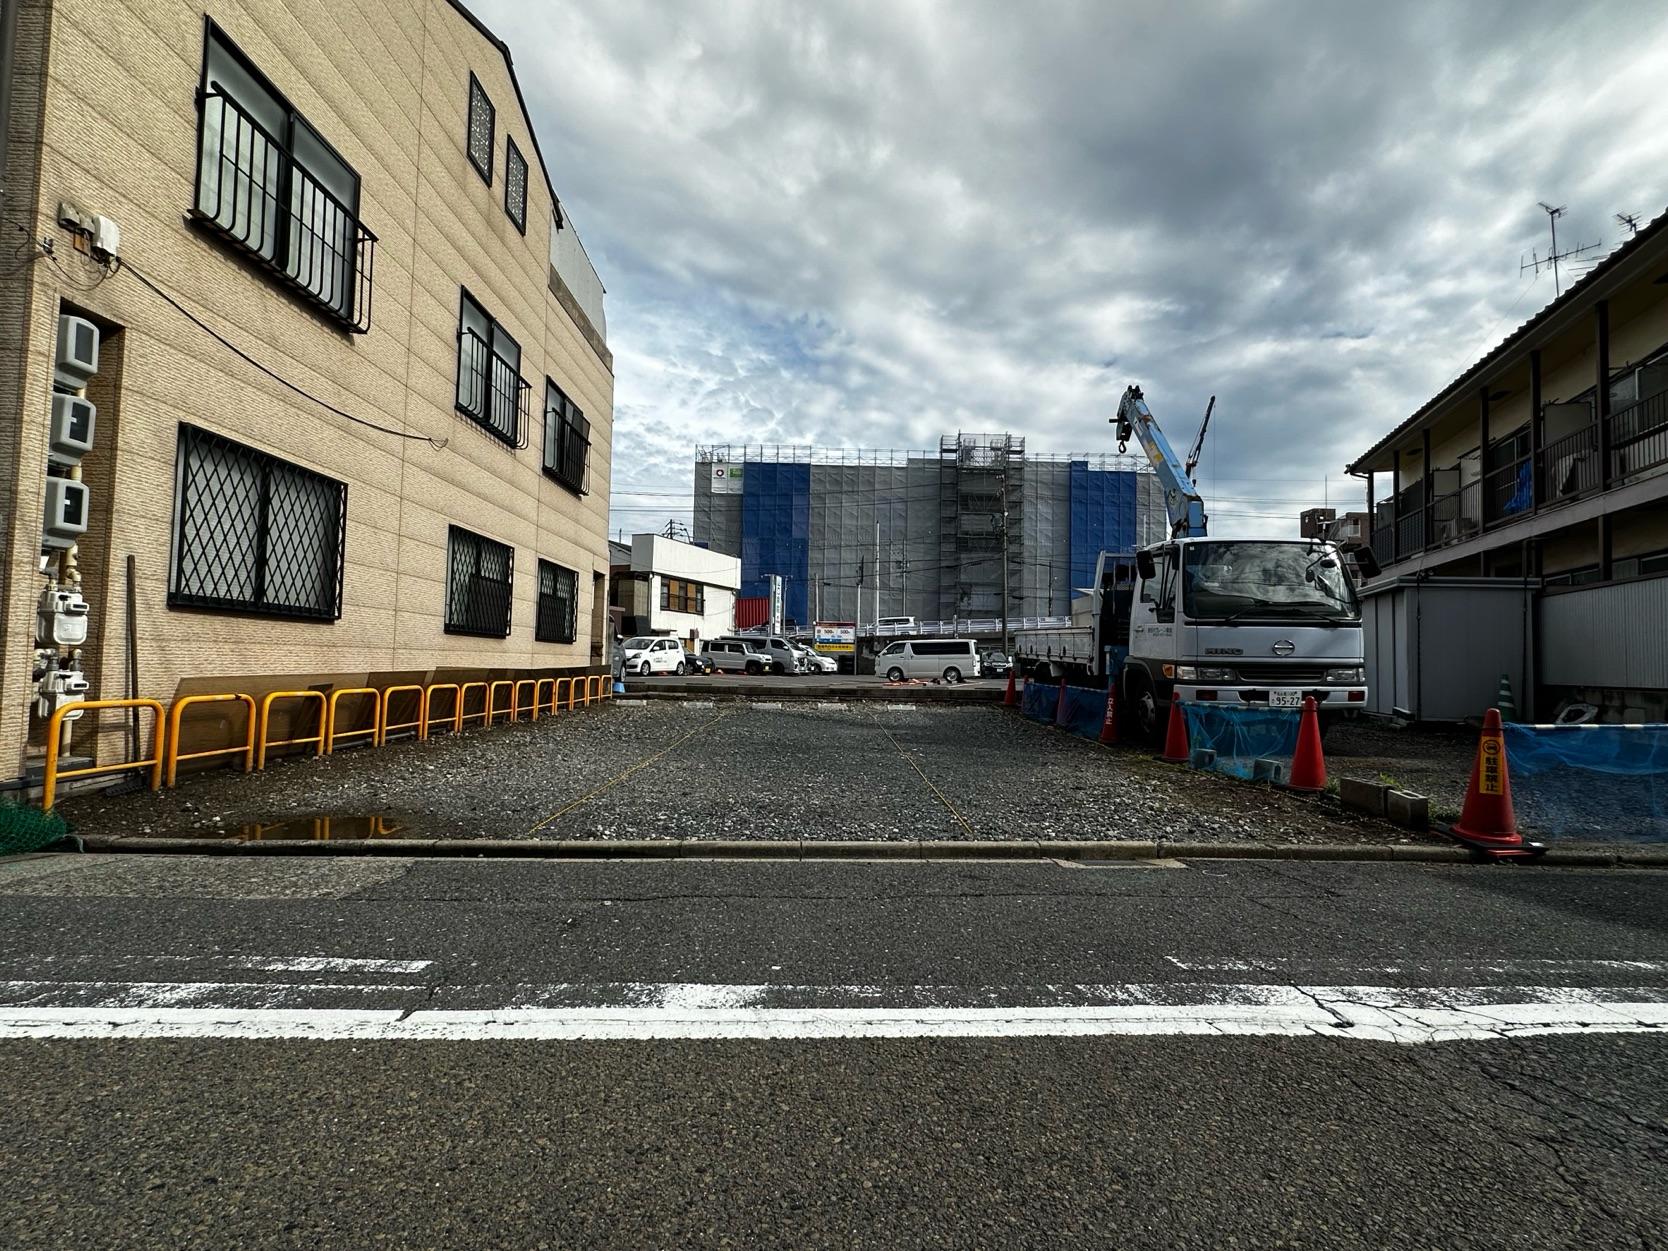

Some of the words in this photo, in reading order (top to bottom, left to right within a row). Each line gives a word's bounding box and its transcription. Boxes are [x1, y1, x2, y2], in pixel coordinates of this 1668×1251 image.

[1276, 697, 1300, 705] 95-27
[1485, 757, 1498, 792] 駐車禁止
